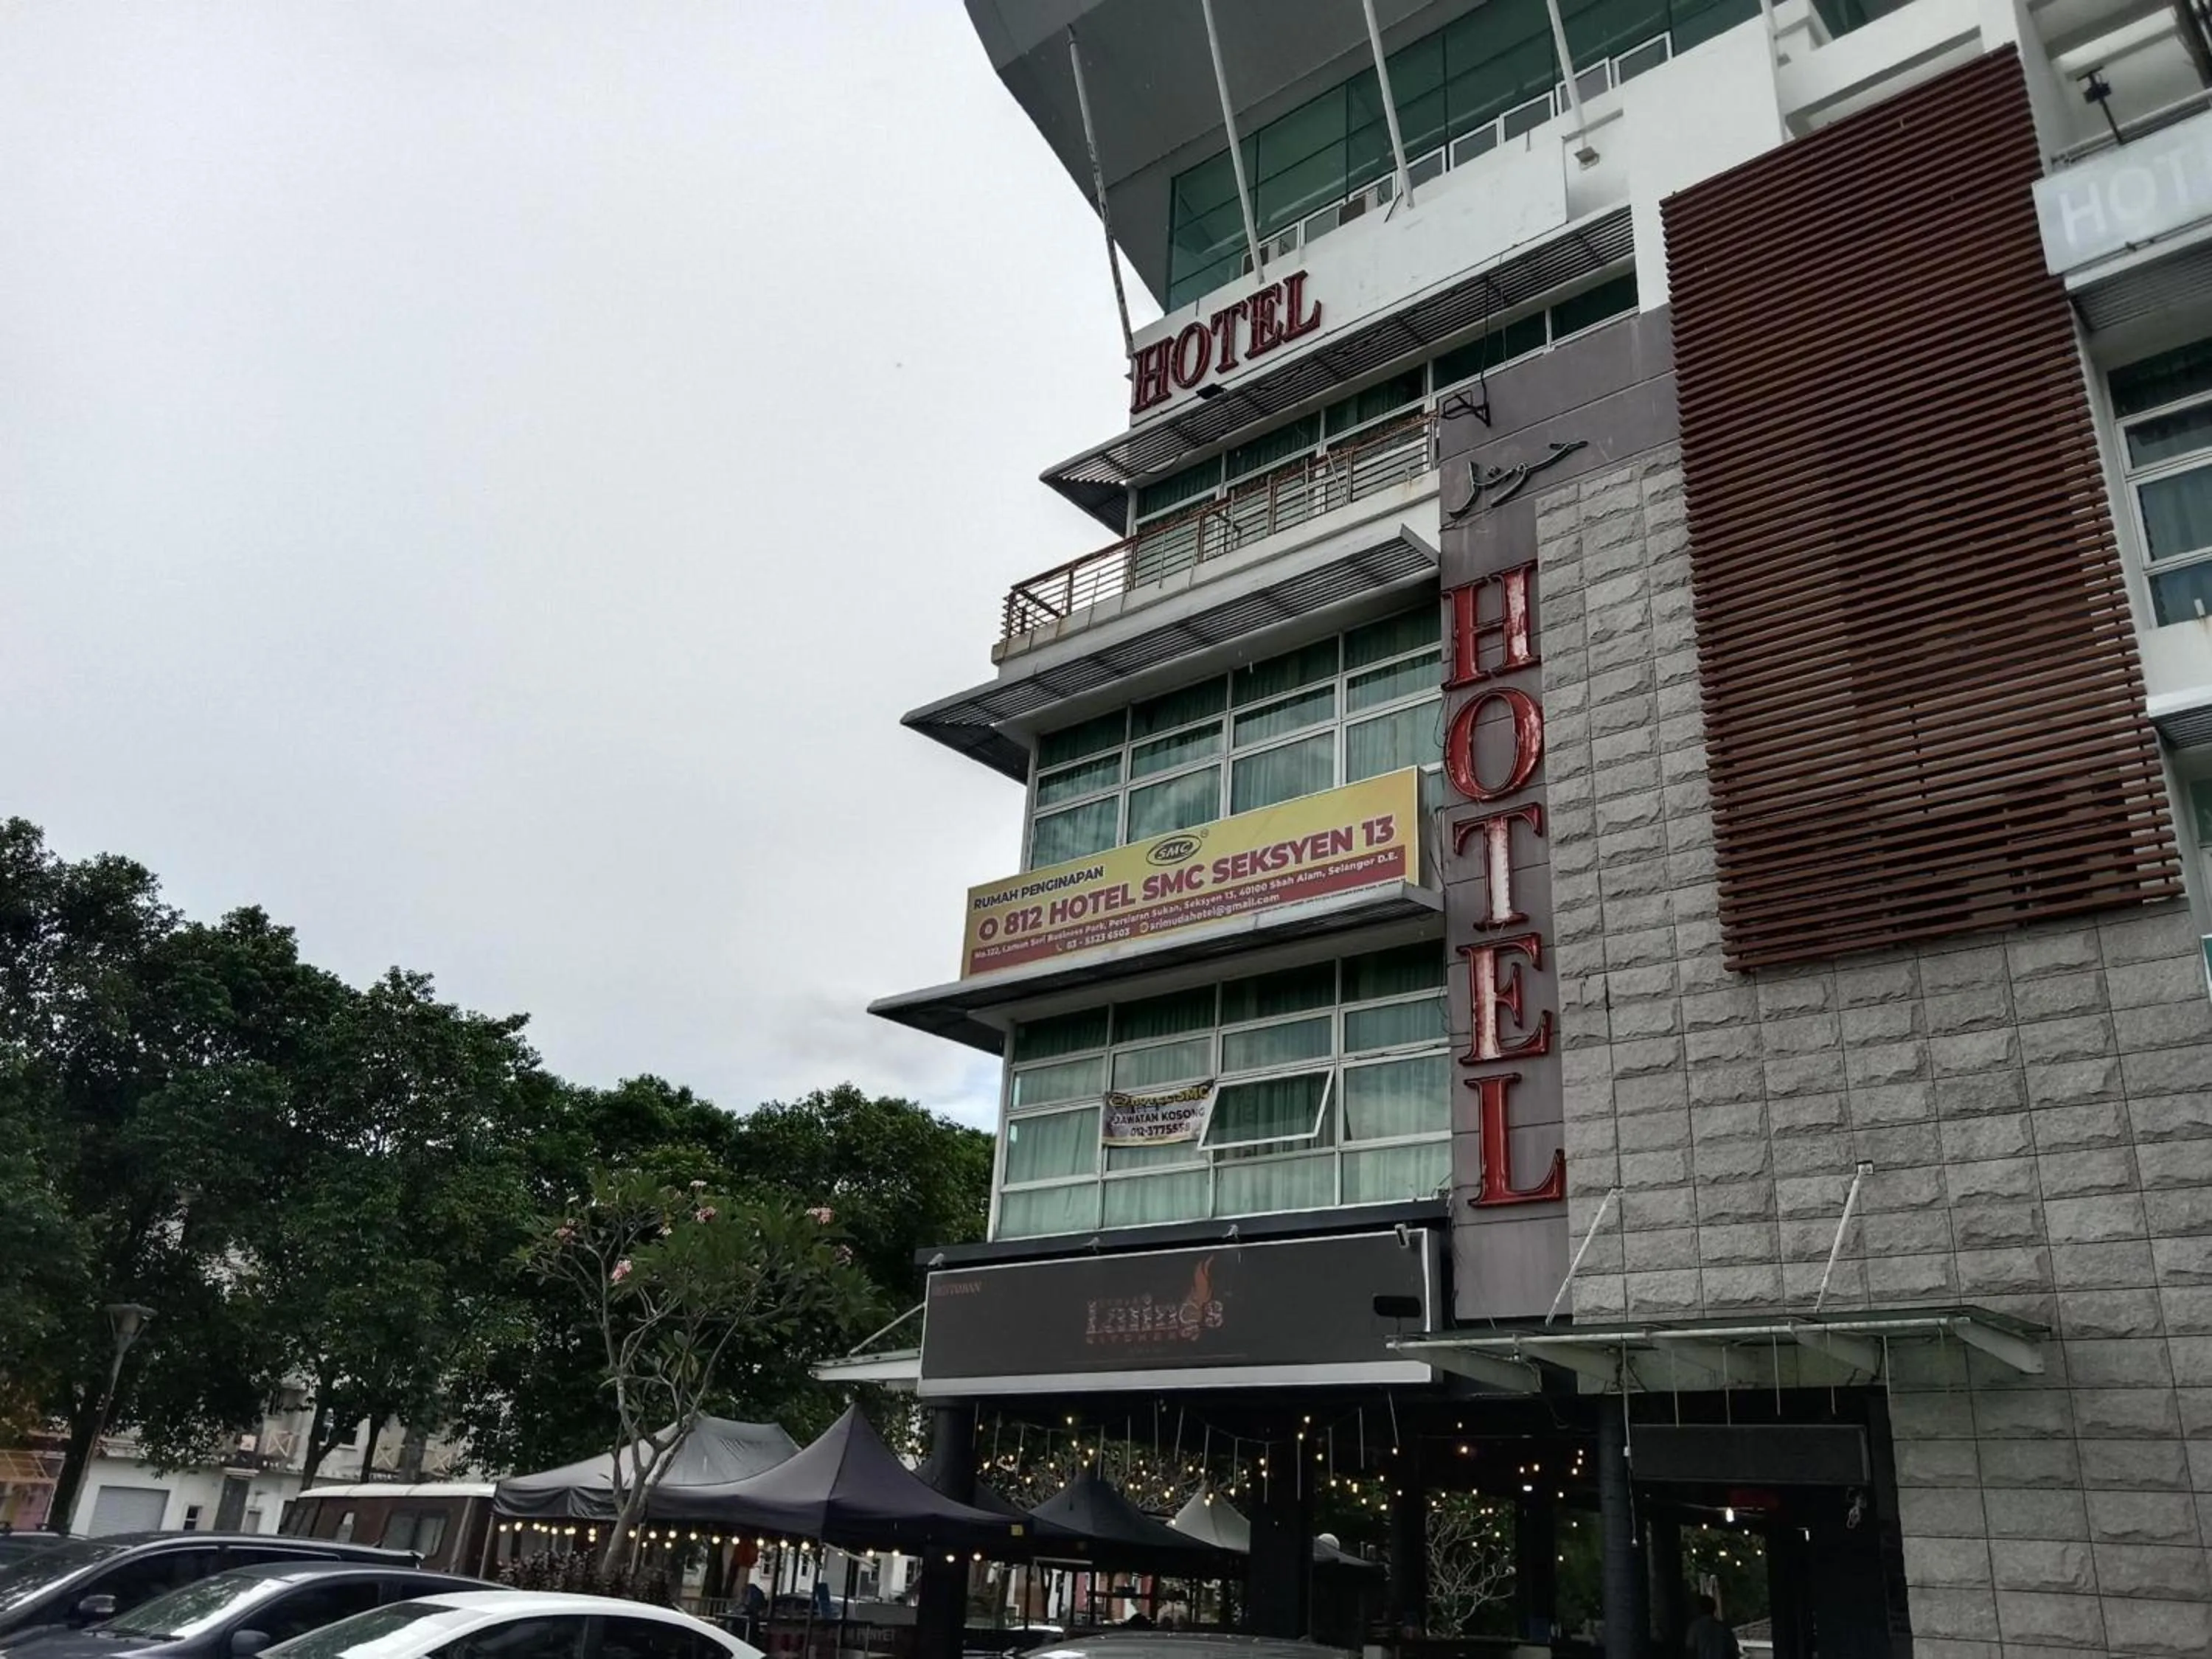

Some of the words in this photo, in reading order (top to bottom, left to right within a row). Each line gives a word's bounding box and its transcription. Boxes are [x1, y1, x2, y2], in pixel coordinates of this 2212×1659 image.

[2059, 142, 2212, 249] HOT
[1130, 269, 1322, 414] HOTEL
[973, 889, 1018, 910] RUMAH
[1021, 866, 1104, 899] PENGINAPAN
[1004, 906, 1043, 935] 812
[1049, 883, 1136, 925] HOTEL
[1142, 864, 1205, 901] SMC
[1212, 825, 1353, 883] SEKSYEN
[1363, 814, 1395, 846] 13
[1108, 911, 1150, 928] Persiaran
[1152, 904, 1183, 917] Sukan,
[1183, 894, 1223, 910] Seksyen
[1269, 876, 1294, 890] Shah
[1296, 869, 1326, 883] Alam,
[1328, 857, 1375, 875] Selangor
[1377, 851, 1399, 863] D.E.
[1157, 841, 1193, 860] SMC
[1441, 559, 1569, 1208] HOTEL
[1161, 1107, 1206, 1121] KOSONG
